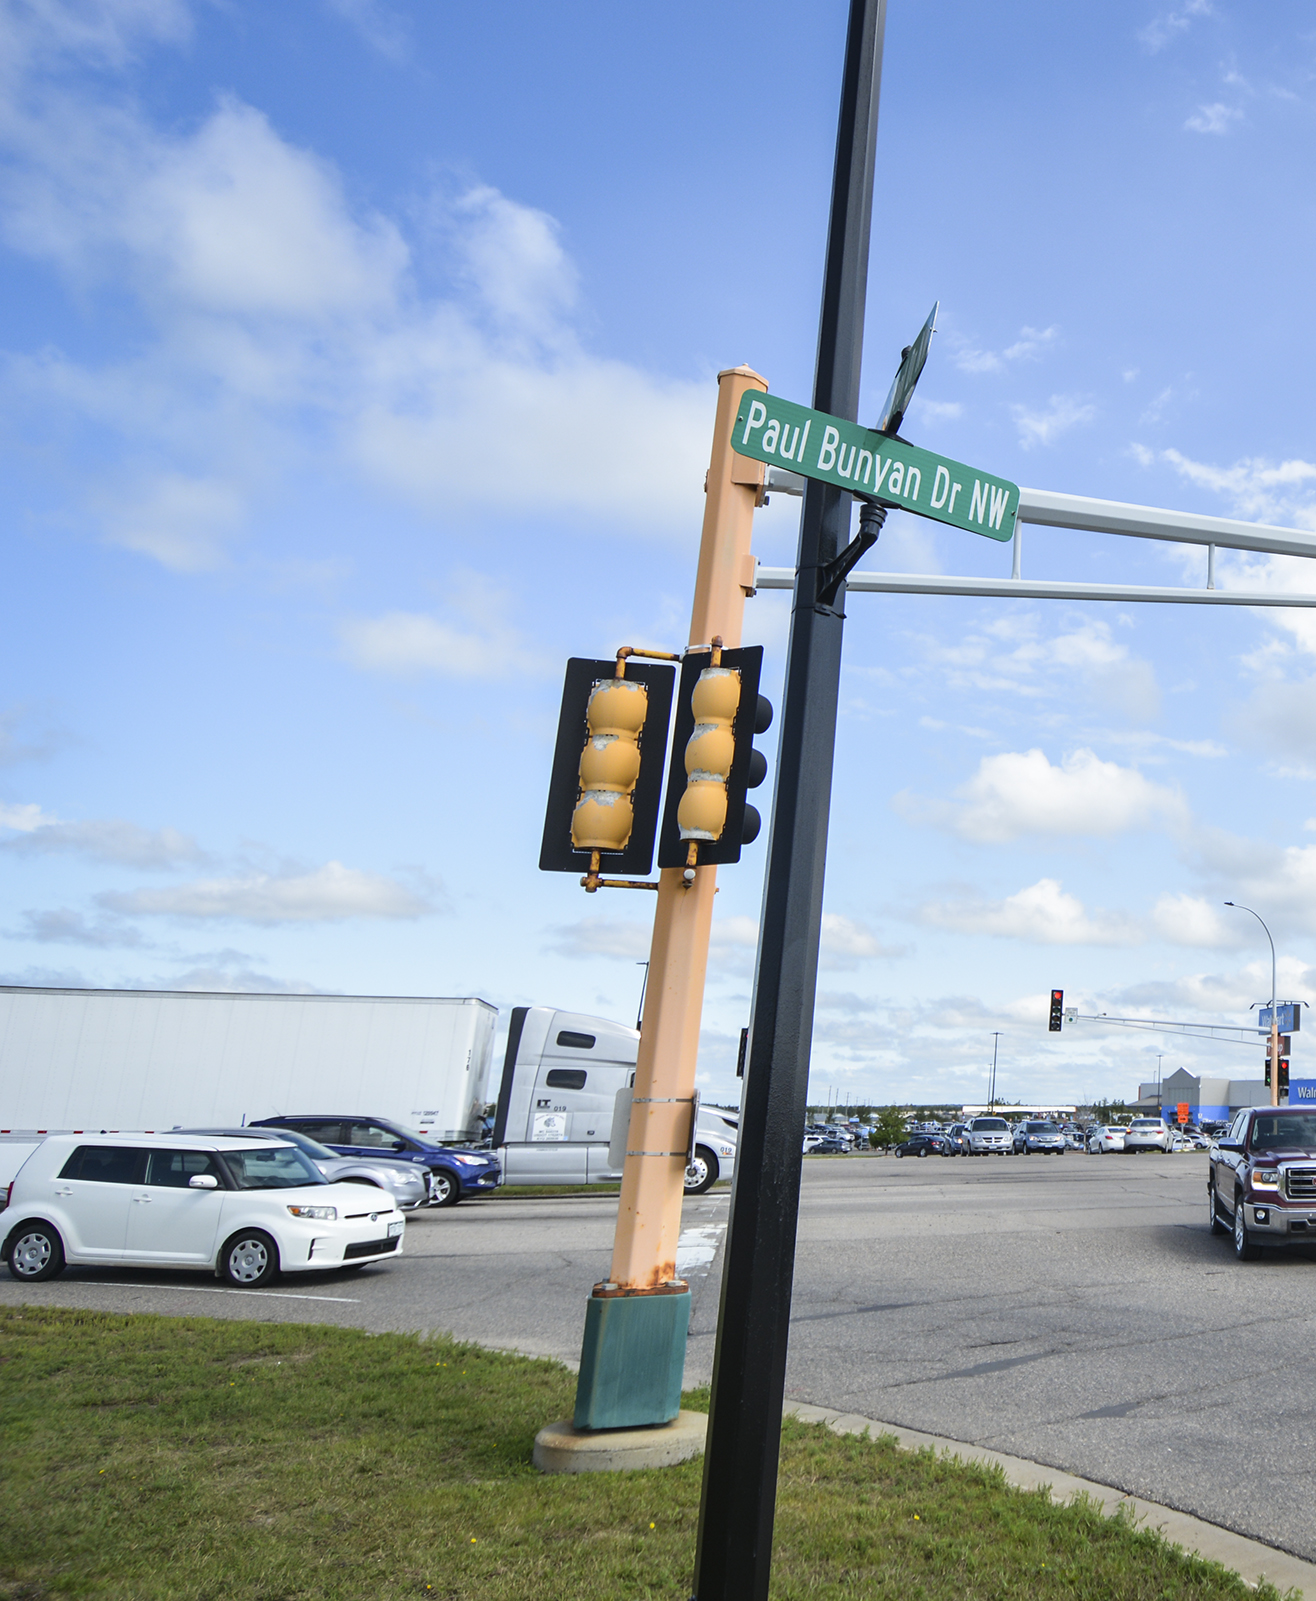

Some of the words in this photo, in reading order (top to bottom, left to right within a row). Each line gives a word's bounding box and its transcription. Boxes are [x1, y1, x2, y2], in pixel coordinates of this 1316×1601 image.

[742, 400, 812, 462] Paul
[816, 425, 921, 501] Bunyan
[930, 465, 962, 514] Dr
[968, 479, 1010, 531] NW
